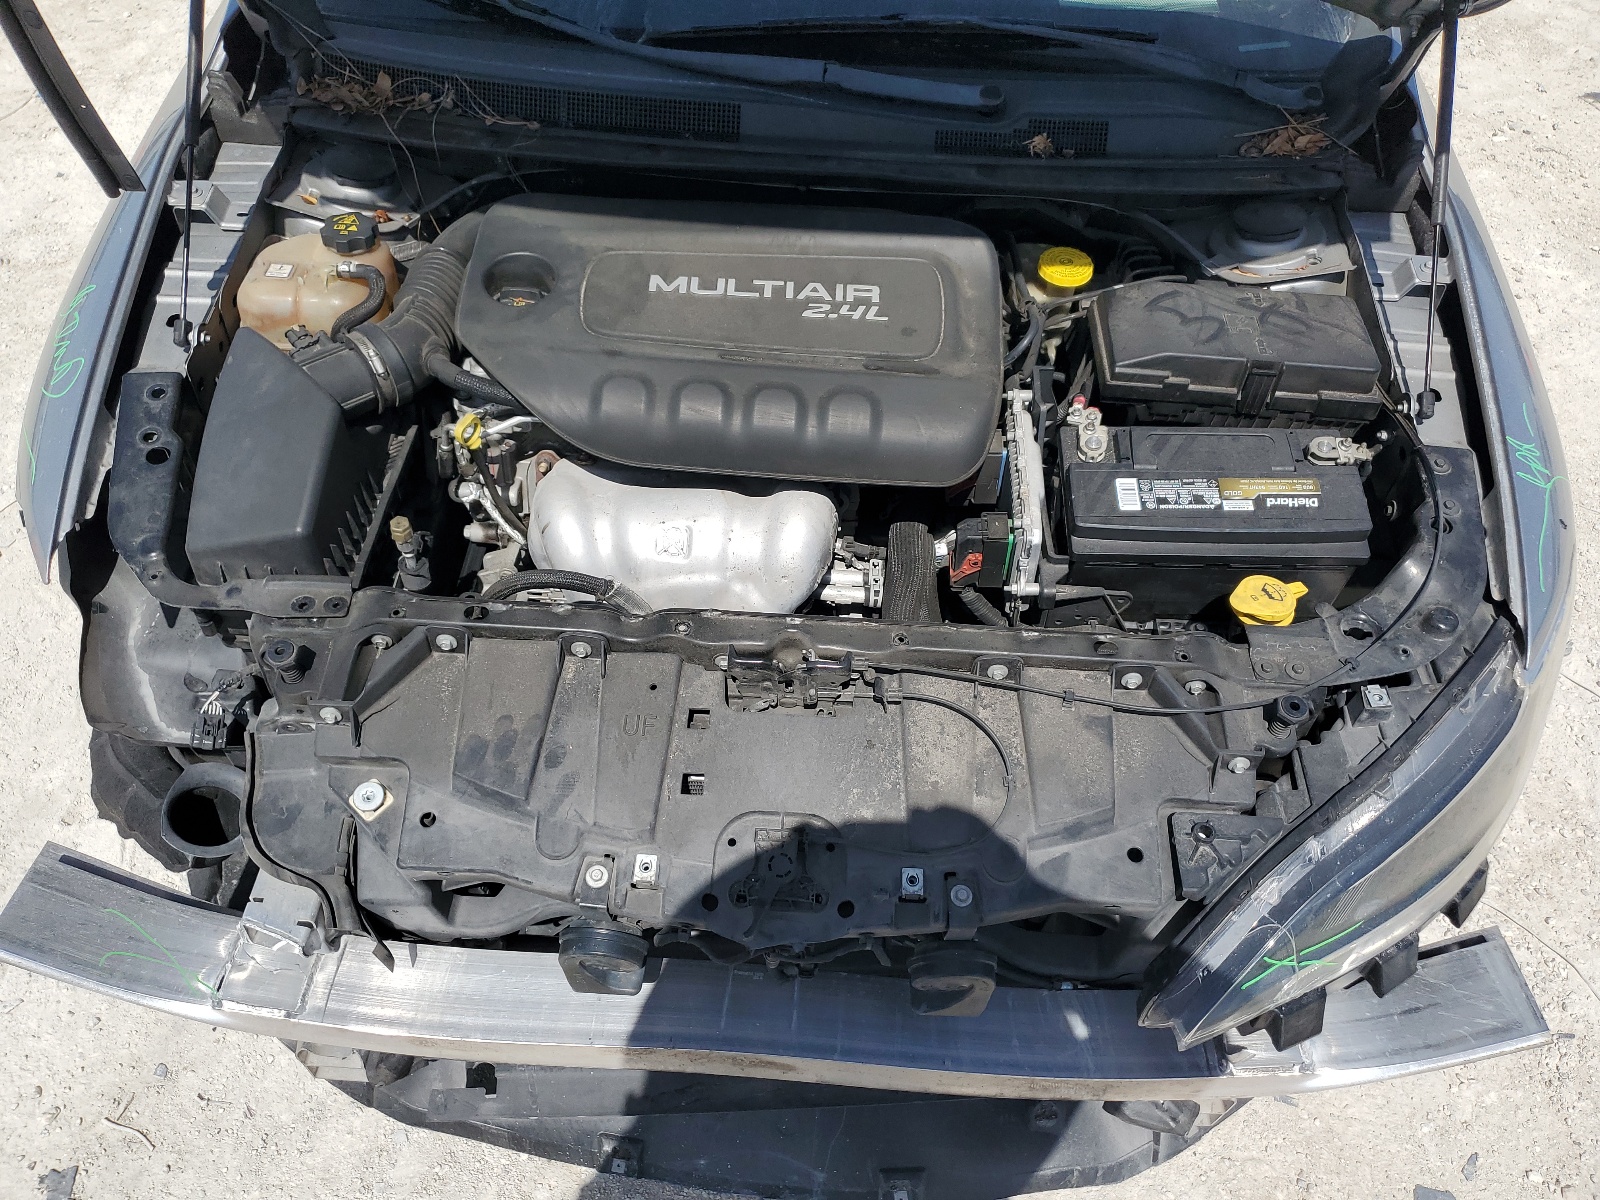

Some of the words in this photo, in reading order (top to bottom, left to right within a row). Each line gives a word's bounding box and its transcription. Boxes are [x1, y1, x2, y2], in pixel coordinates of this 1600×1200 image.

[648, 274, 881, 303] MULTIAIR
[801, 303, 889, 321] 2.4L
[1266, 497, 1319, 508] DieHard
[623, 713, 658, 737] UF
